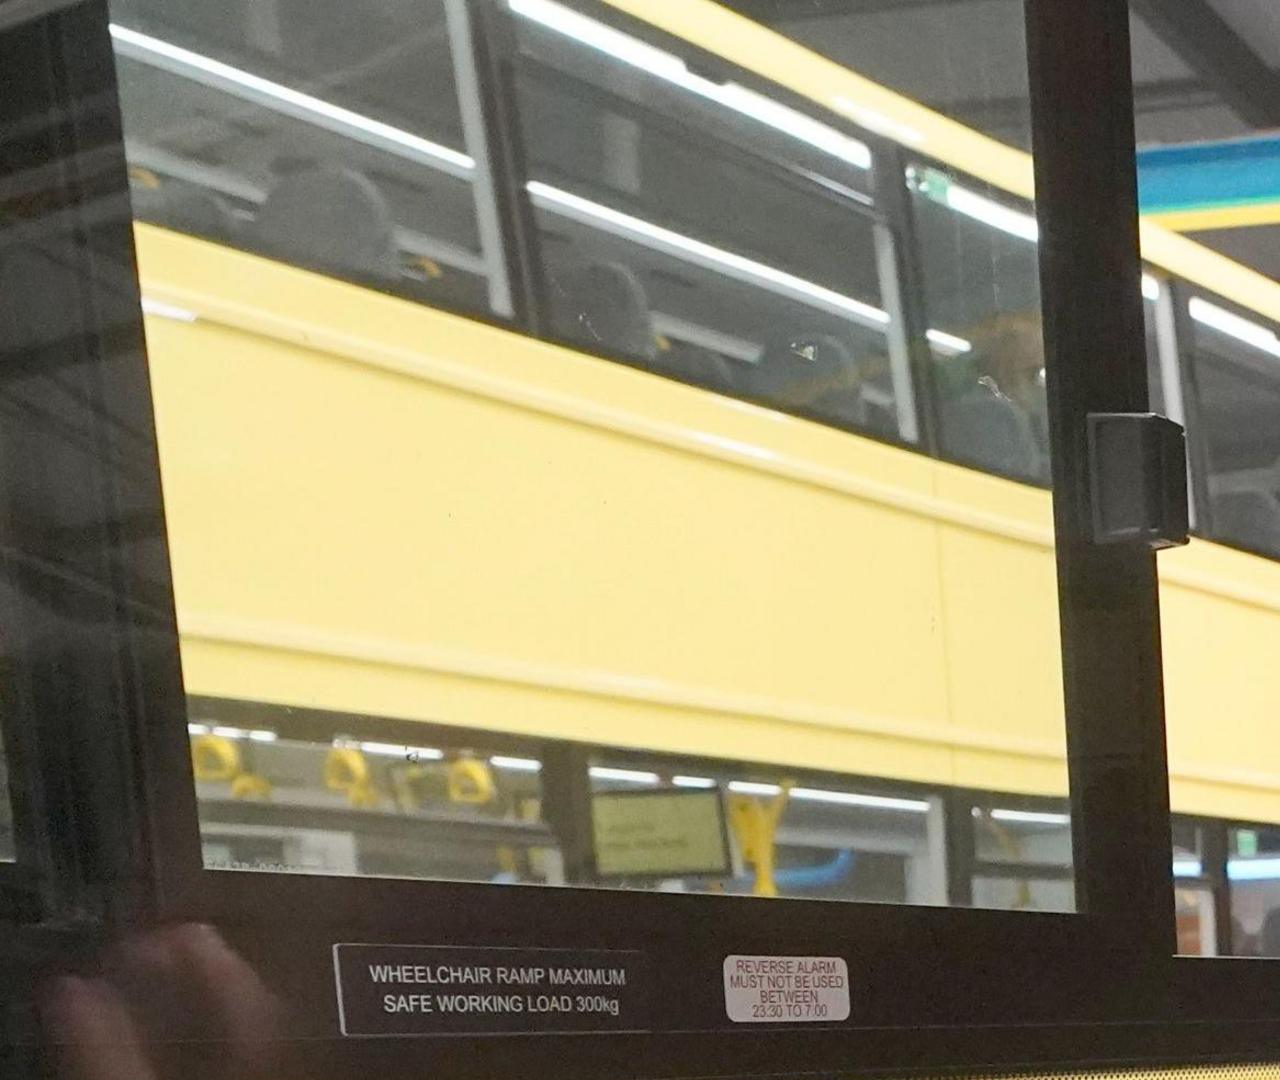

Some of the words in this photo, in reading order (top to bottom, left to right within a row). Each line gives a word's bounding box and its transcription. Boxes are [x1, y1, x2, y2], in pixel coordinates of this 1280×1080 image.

[736, 959, 794, 974] REVERSE
[797, 960, 837, 975] ALARM
[368, 964, 492, 985] WHEELCHAIR
[496, 967, 545, 985] RAMP
[549, 968, 626, 986] MAXIMUM
[729, 974, 764, 989] MUST
[767, 974, 792, 989] NOT
[794, 974, 811, 989] BE
[812, 974, 844, 989] USED
[759, 990, 819, 1004] BETWEEN
[383, 994, 433, 1013] SAFE
[436, 995, 524, 1013] WORKING
[527, 995, 572, 1013] LOAD
[576, 995, 620, 1016] 300kg
[786, 1004, 801, 1017] TO
